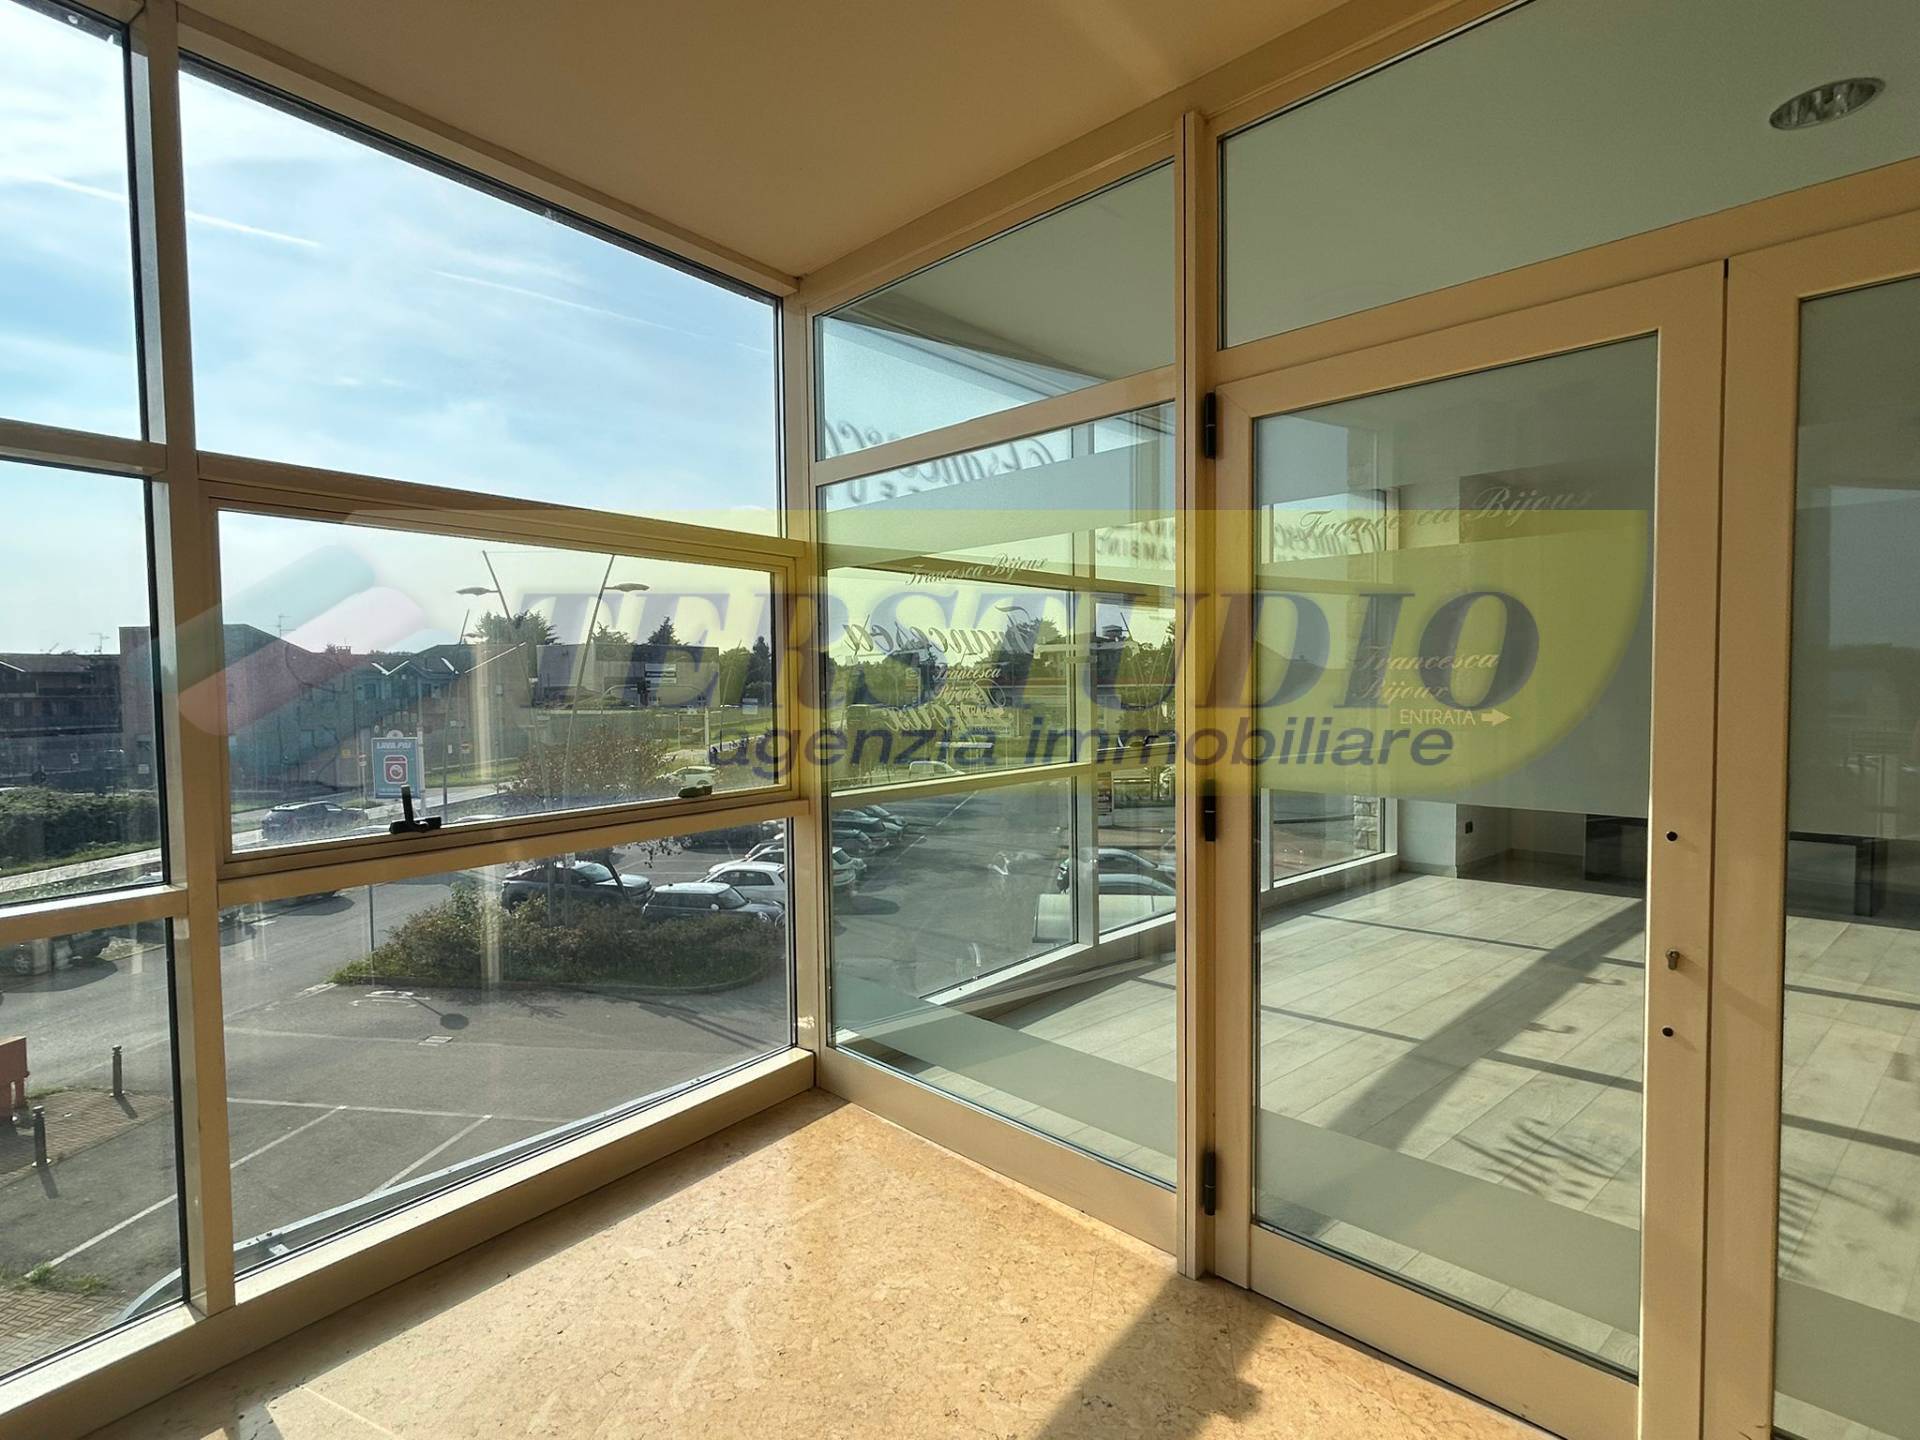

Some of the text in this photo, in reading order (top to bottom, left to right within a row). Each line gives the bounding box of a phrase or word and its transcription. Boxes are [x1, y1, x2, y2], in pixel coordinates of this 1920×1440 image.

[905, 552, 1048, 586] Francesca Bijoux
[1352, 645, 1499, 671] Francesca
[1353, 676, 1449, 704] Bijoux
[1400, 708, 1476, 725] ENTRATA
